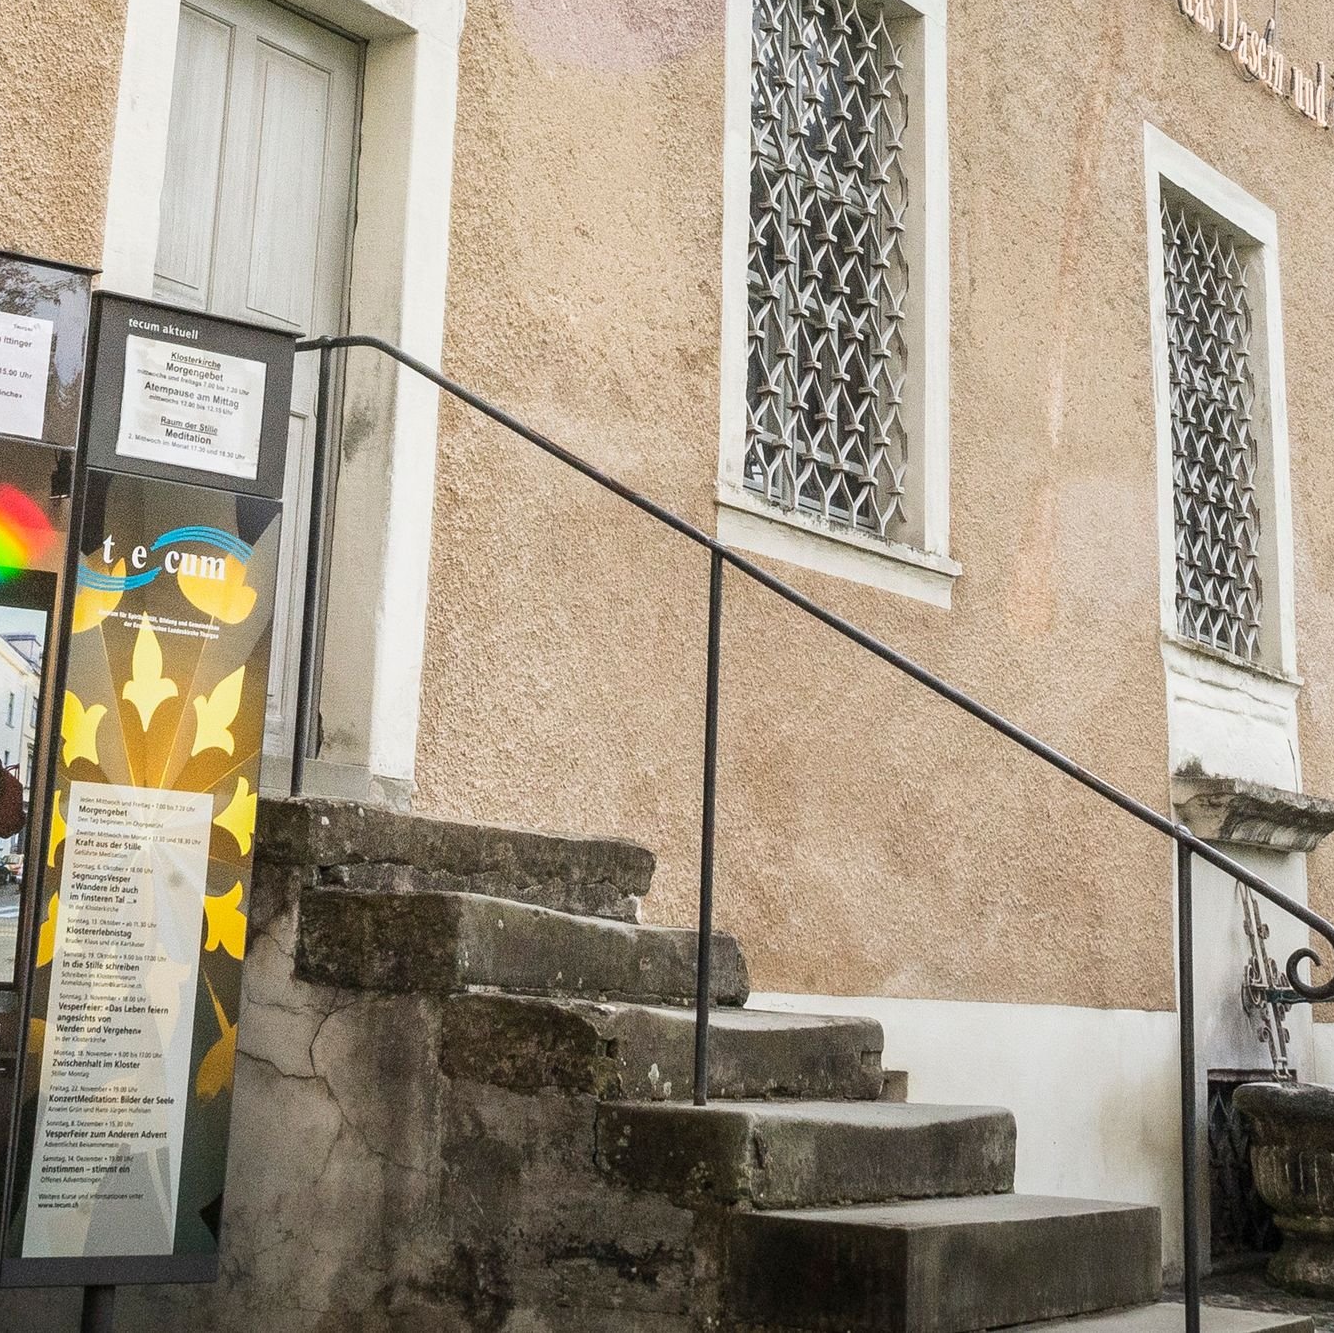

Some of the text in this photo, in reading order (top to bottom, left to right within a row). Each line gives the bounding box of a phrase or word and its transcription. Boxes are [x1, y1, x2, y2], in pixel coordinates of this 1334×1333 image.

[1292, 62, 1327, 128] und
[128, 318, 199, 340] tecum aktuell
[170, 351, 222, 371] Klosterkirche
[165, 362, 224, 382] Morgengebet
[144, 381, 239, 411] Atempause am Mittag
[160, 415, 218, 437] Raum der Stille
[164, 427, 212, 445] Meditation
[78, 804, 128, 818] Morgengebet
[75, 838, 142, 851] Kraft aus der Stille
[71, 871, 131, 884] SegnungsVesper
[109, 884, 120, 893] ich
[121, 885, 139, 894] auch
[66, 926, 133, 940] Klostererlebnistag
[62, 959, 140, 972] In die Stille schreiben
[123, 1004, 146, 1014] Leben
[147, 1005, 169, 1014] feiern
[56, 1023, 142, 1037] Werden und Vergehen»
[52, 1058, 141, 1069] Zwischenhalt im Kloster
[120, 1095, 141, 1104] Bilder
[142, 1095, 155, 1105] der
[155, 1096, 175, 1105] Seele
[45, 1129, 167, 1140] VesperFeier zum Anderen Advent
